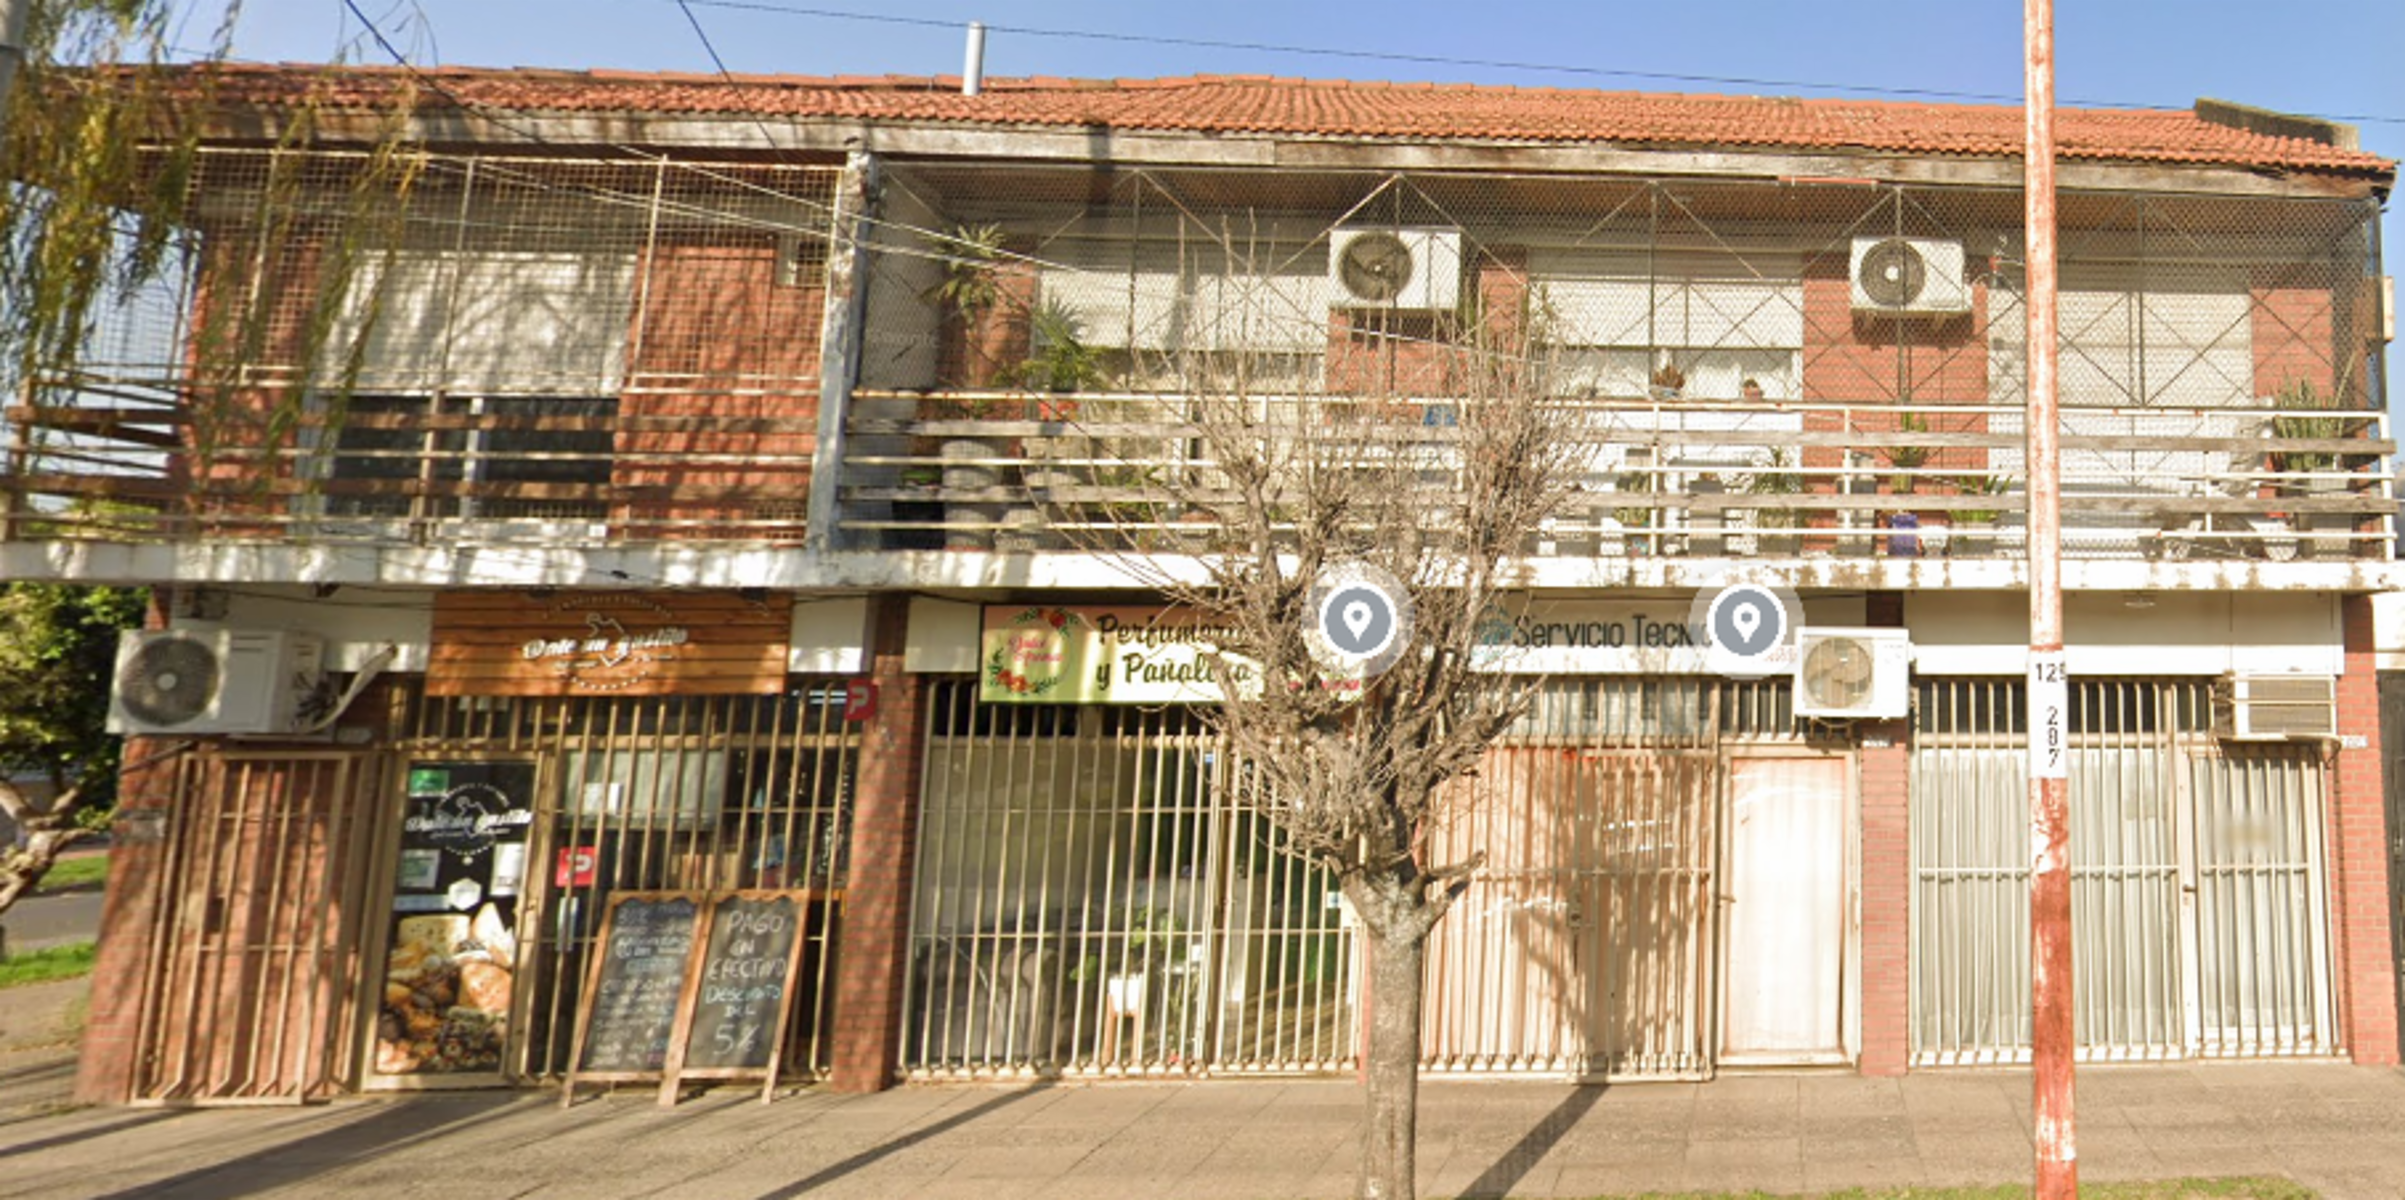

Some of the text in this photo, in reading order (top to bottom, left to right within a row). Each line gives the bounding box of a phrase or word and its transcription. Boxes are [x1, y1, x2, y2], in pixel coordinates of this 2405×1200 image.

[1512, 615, 1625, 648] Servicio
[1096, 663, 1110, 691] y
[727, 910, 784, 935] PAGO
